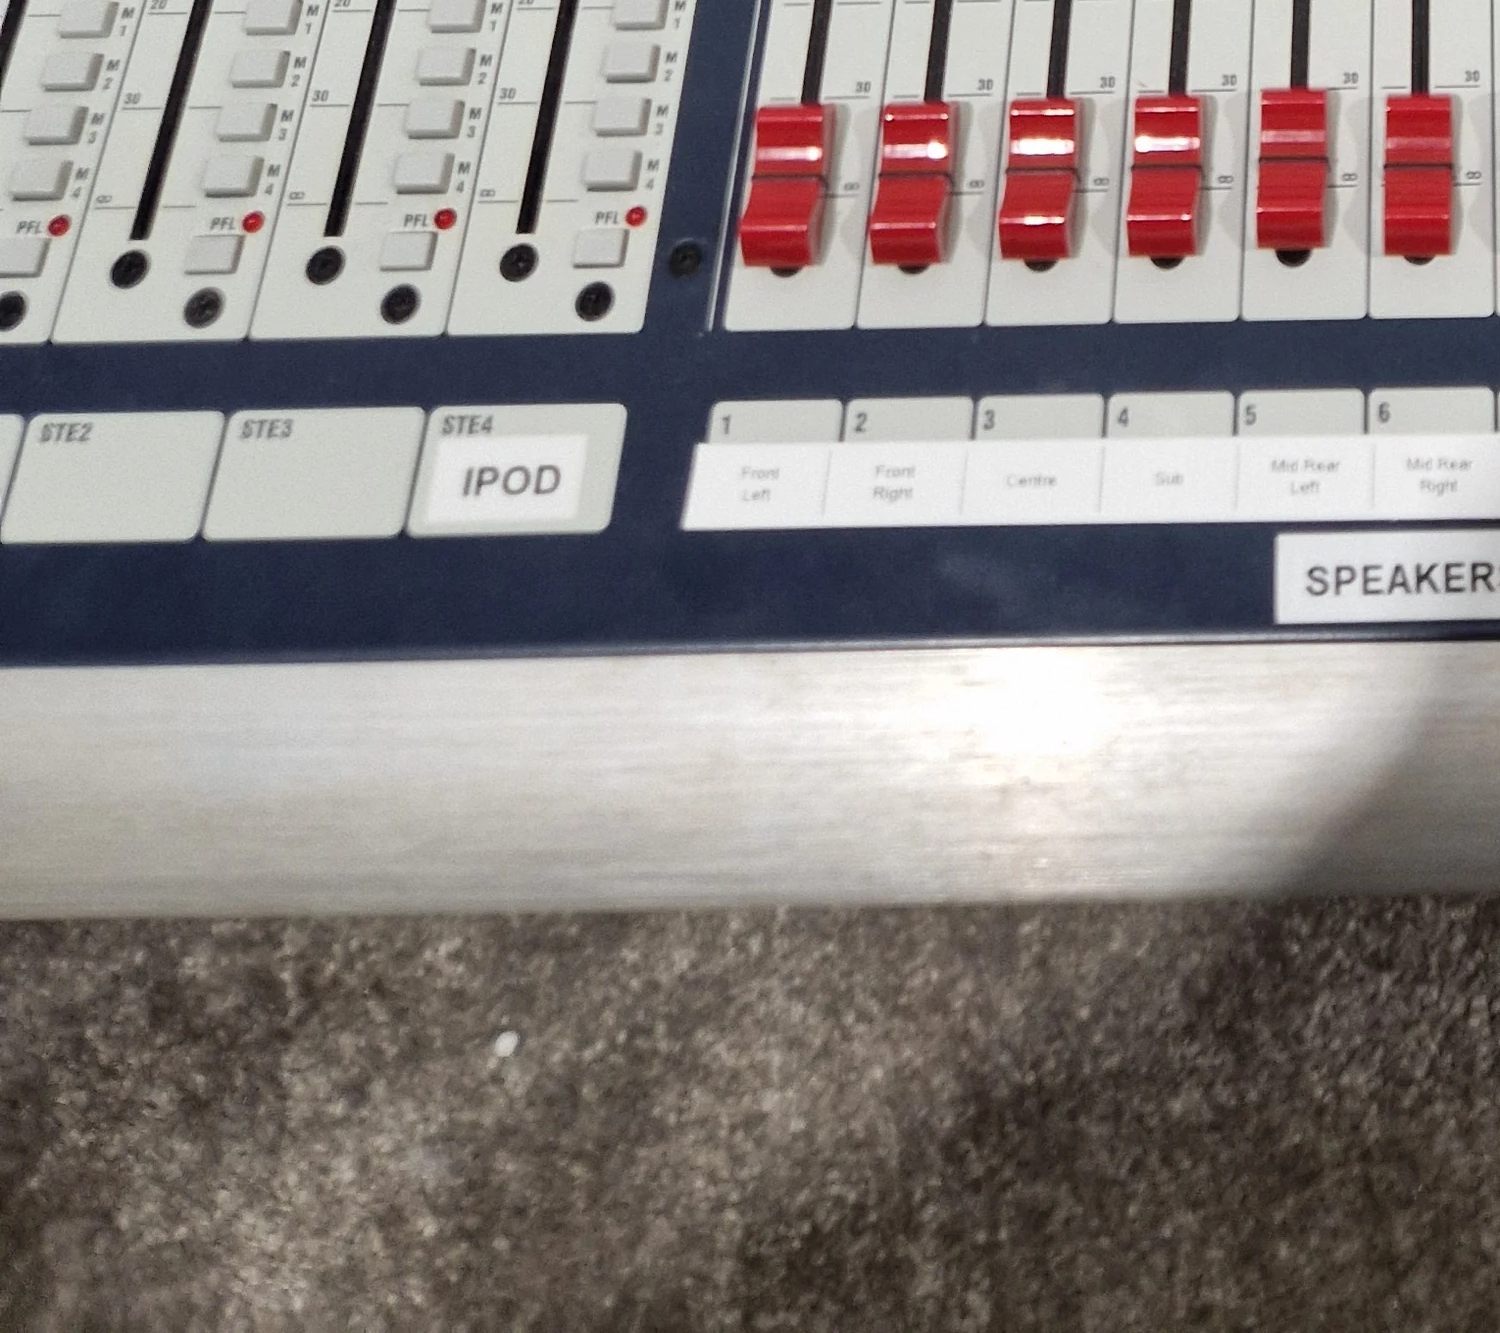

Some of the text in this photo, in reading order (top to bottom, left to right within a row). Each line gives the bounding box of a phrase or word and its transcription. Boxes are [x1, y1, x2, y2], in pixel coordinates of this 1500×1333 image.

[595, 210, 619, 224] PFL
[984, 410, 995, 430] 3
[1118, 407, 1129, 427] 4
[1246, 405, 1256, 424] 5
[1379, 402, 1390, 423] 6
[240, 419, 293, 439] STE3
[442, 415, 494, 435] STE4
[722, 416, 730, 435] 1
[855, 413, 867, 433] 2
[39, 423, 92, 443] STE2
[875, 464, 915, 479] Front
[1006, 472, 1057, 488] Centre
[1155, 471, 1184, 486] Sub
[461, 465, 561, 498] IPOD
[1419, 477, 1458, 495] Right
[873, 484, 914, 502] Right
